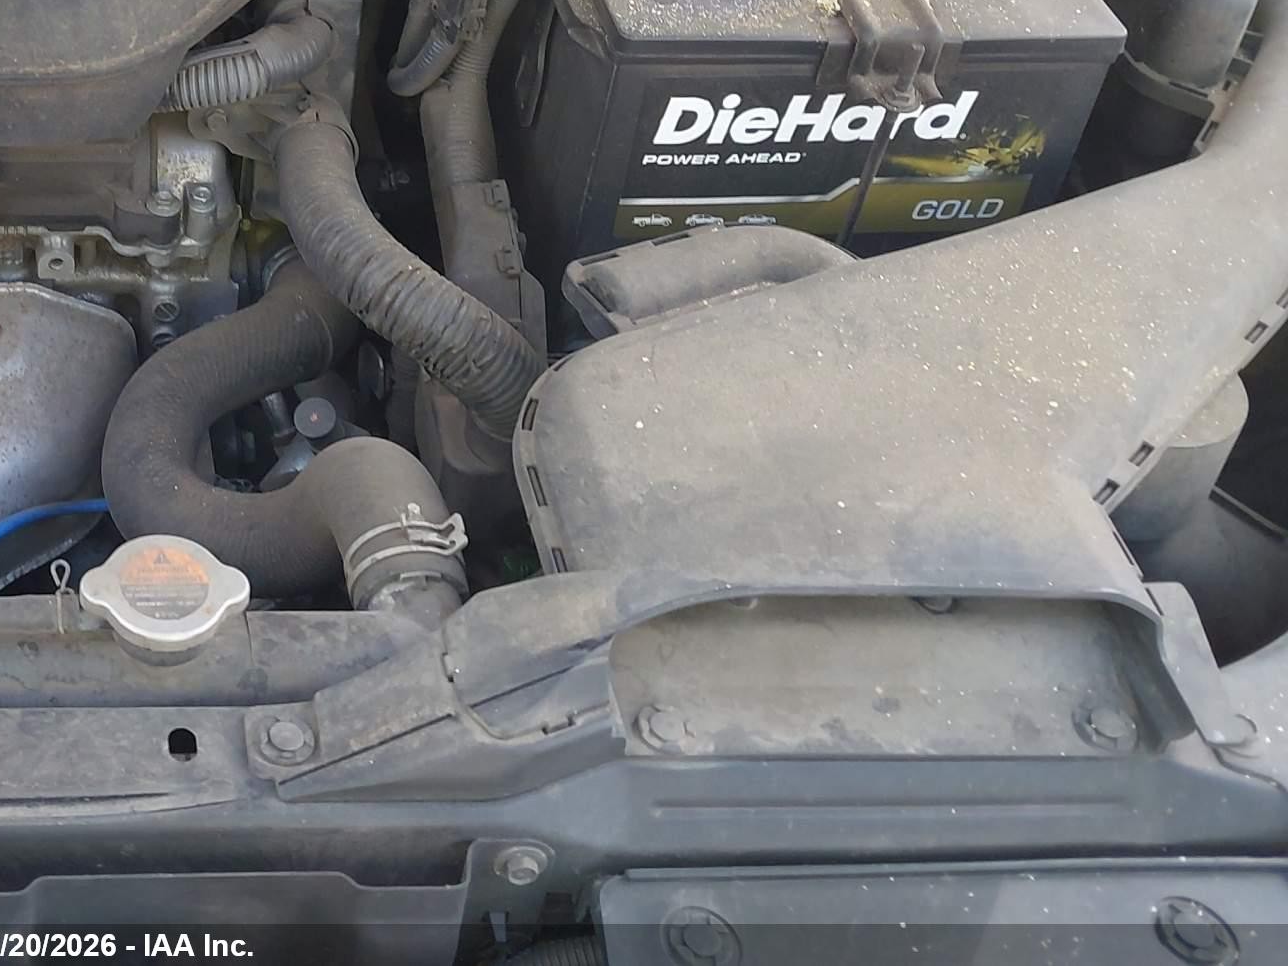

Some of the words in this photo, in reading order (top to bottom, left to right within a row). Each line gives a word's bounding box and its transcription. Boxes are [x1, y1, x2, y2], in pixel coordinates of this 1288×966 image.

[652, 91, 979, 145] DieHard
[642, 153, 720, 166] POWER
[725, 152, 802, 164] AHEAD
[912, 198, 1004, 220] GOLD
